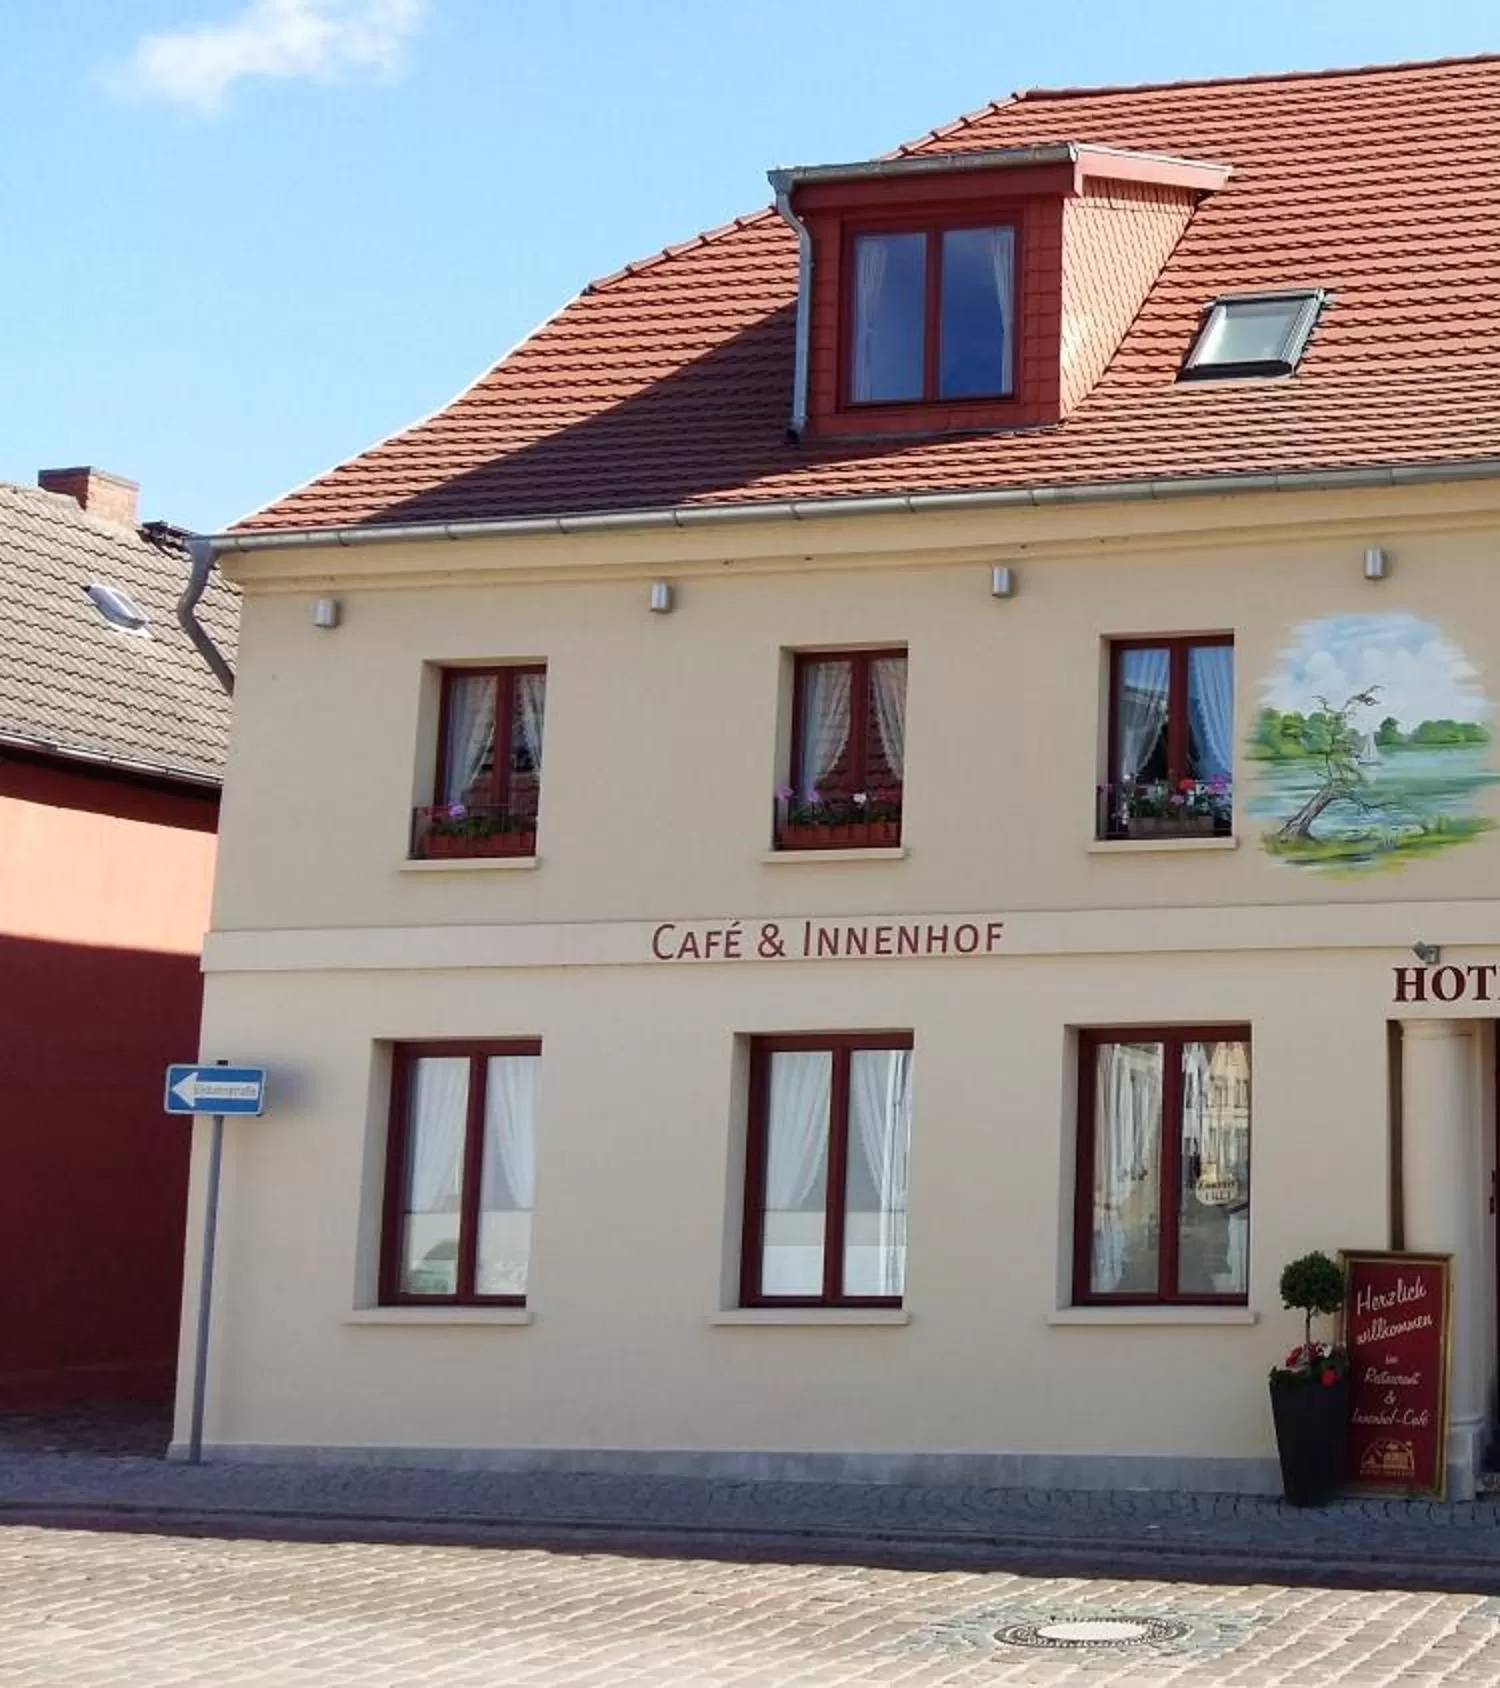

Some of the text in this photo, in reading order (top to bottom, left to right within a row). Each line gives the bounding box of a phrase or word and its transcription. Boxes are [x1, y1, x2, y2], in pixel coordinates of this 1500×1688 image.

[652, 921, 1004, 960] CAFÉ & INNENHOF
[1356, 1275, 1427, 1316] Herzlich
[1355, 1313, 1433, 1345] willkommen
[1364, 1367, 1421, 1385] Restaurant
[1383, 1390, 1397, 1406] &
